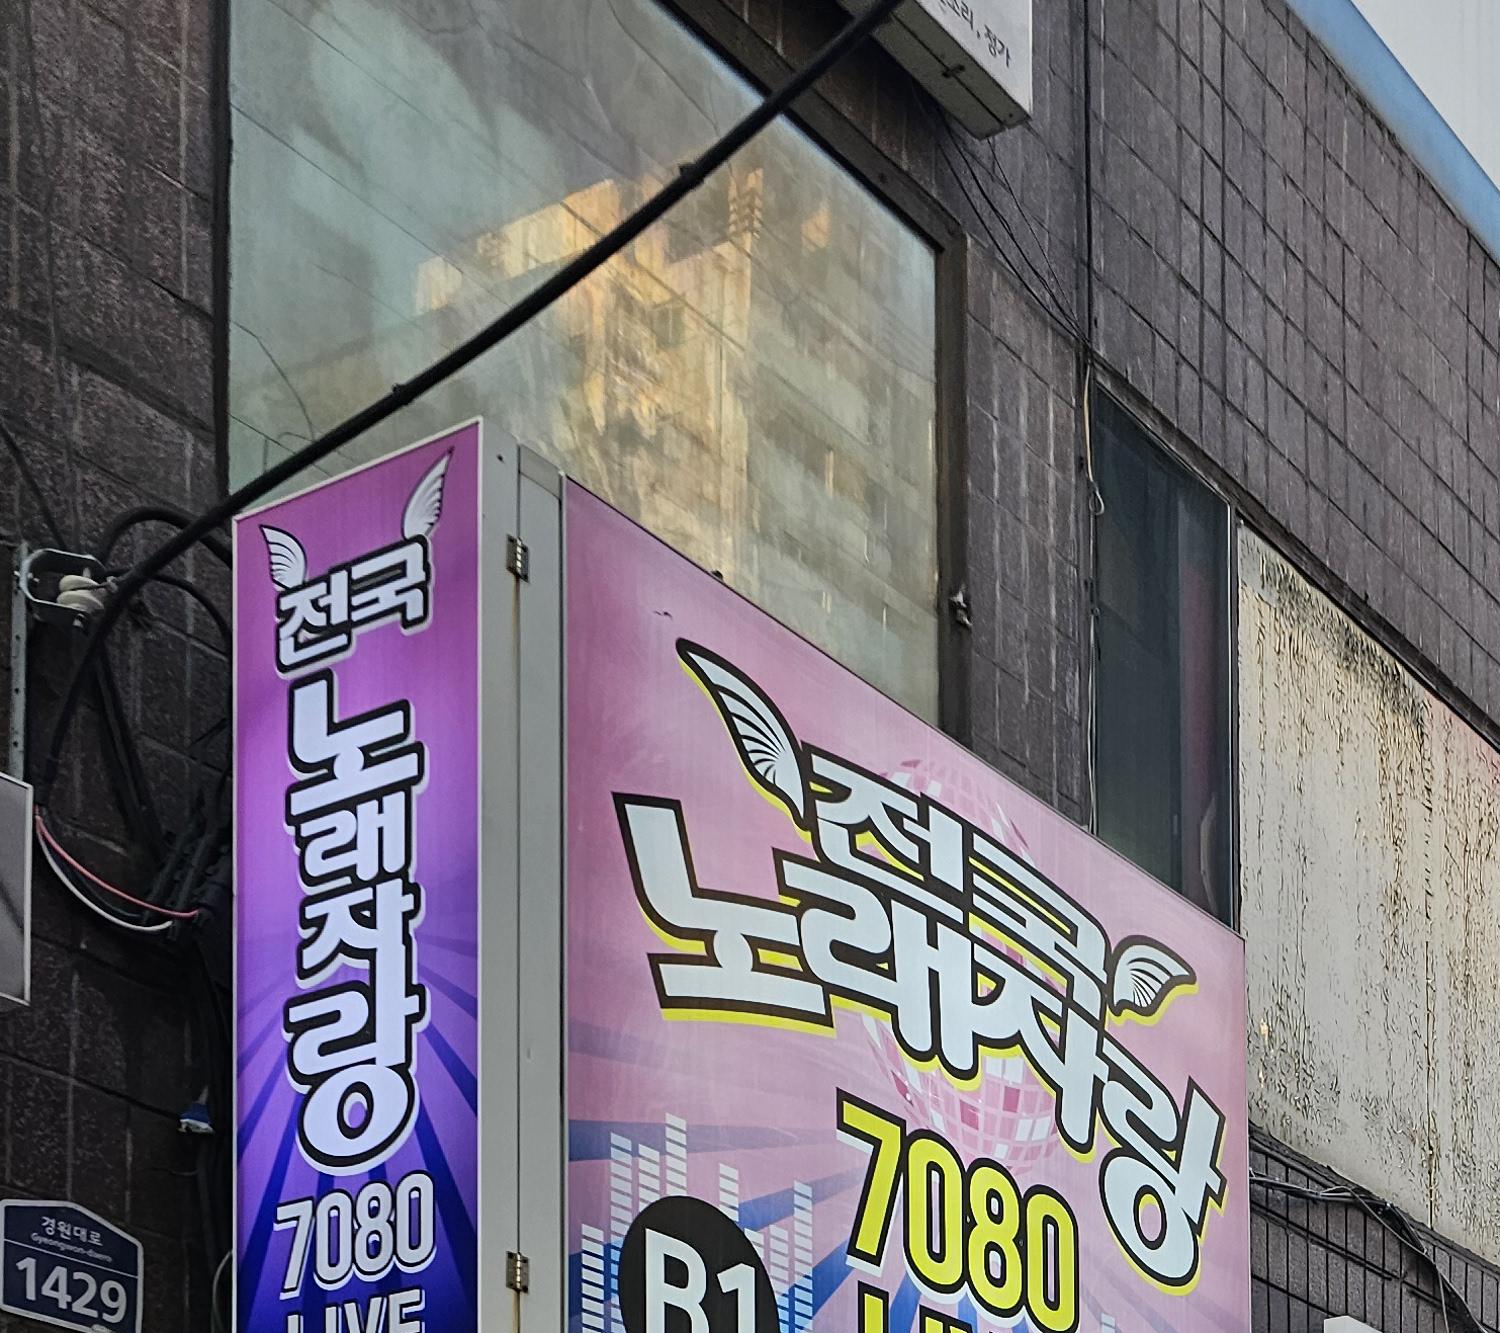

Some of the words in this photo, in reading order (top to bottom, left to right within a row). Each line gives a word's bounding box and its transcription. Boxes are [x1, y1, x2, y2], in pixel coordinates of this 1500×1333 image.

[278, 539, 427, 668] 전국
[288, 672, 423, 1168] 노래자랑
[805, 746, 1106, 1022] 전국
[613, 793, 1224, 1287] 노래자랑
[16, 1256, 128, 1324] 1429
[41, 1216, 103, 1247] 경원대로
[276, 1174, 432, 1297] 7080
